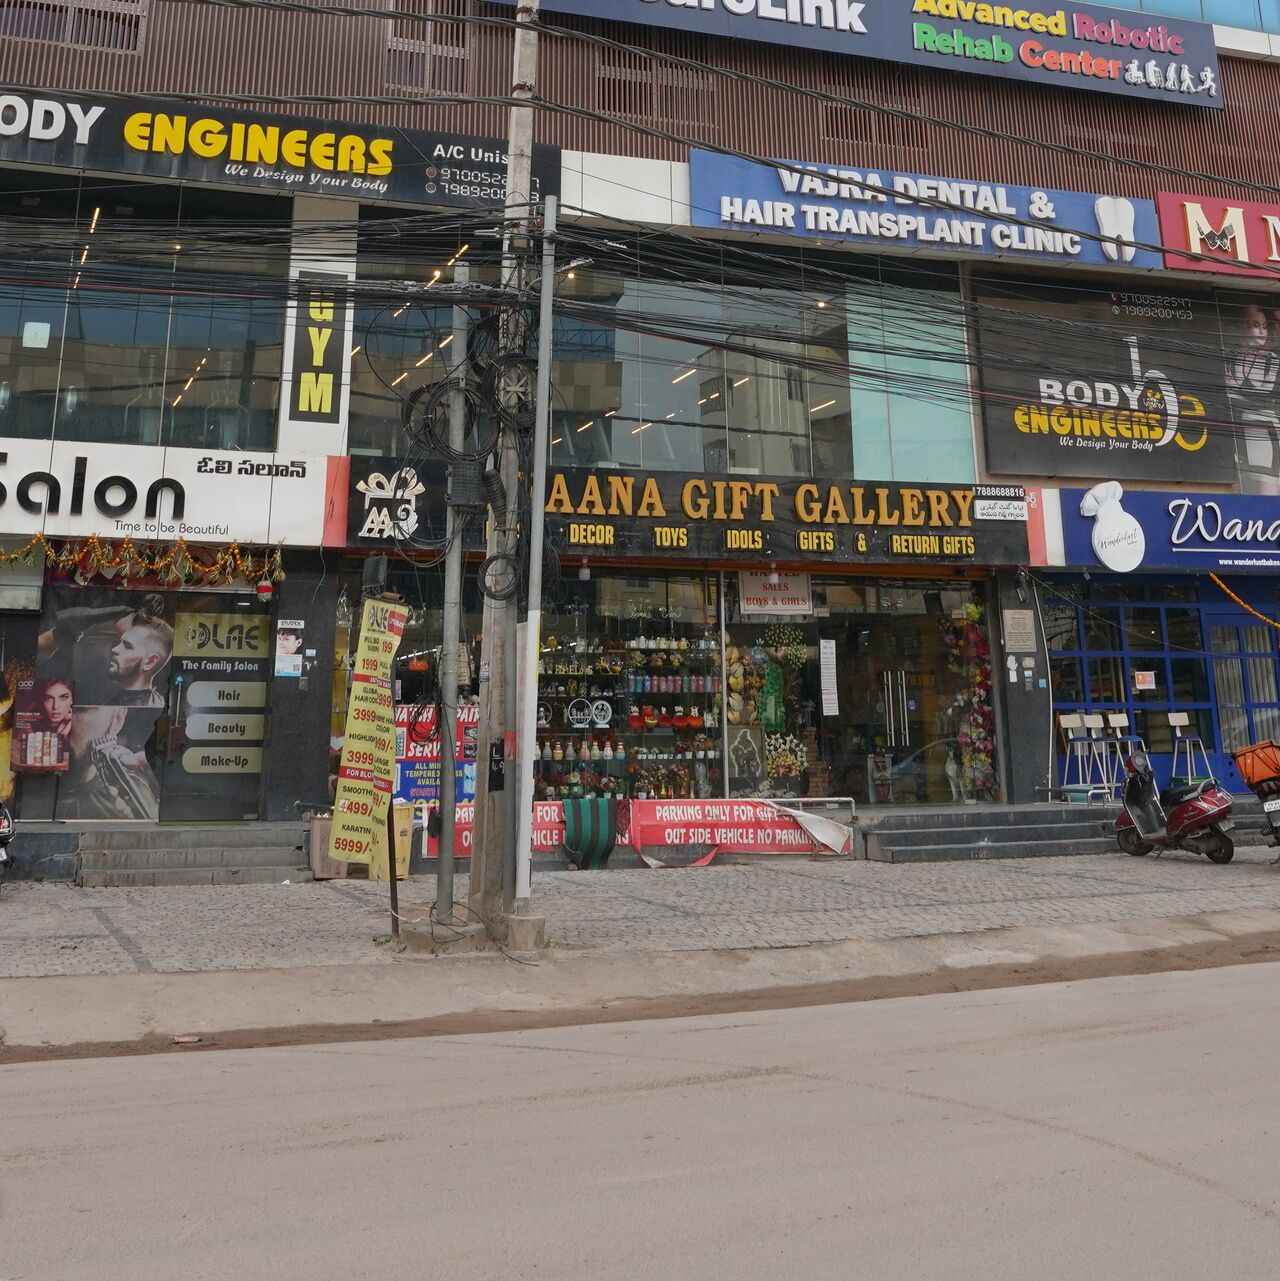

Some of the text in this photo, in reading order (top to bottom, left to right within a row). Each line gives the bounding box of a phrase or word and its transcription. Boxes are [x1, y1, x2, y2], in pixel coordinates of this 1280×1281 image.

[1072, 13, 1185, 55] Robotic
[912, 22, 1121, 79] Rehab Center
[123, 112, 393, 176] ENGINEERS
[433, 143, 464, 160] A/C
[224, 163, 248, 177] We
[253, 167, 304, 185] Design
[351, 177, 389, 194] Body
[440, 167, 540, 189] 97005227
[440, 183, 540, 202] 79892003
[777, 165, 1056, 219] VAJRA DENTAL &
[720, 196, 1081, 255] HAIR TRANSPLANT CLINIC
[298, 292, 334, 414] GYM
[1014, 378, 1163, 439] BODY ENGINEERS
[1059, 436, 1153, 452] We Design Your Body
[544, 473, 976, 527] AANA GIFT GALLERY
[114, 521, 230, 535] Time to be Beautiful
[570, 523, 975, 555] DECOR TOYS IDOLS GIFTS & RETURN GIFTS
[762, 582, 788, 592] SALES
[745, 597, 807, 606] BOYS & GIRLS
[182, 660, 259, 673] The Family Salon
[218, 690, 241, 701] Hair
[207, 722, 246, 736] Beauty
[200, 755, 249, 768] Make-Up
[346, 751, 374, 765] 3999
[537, 804, 558, 821] FOR
[656, 805, 754, 822] PARKING ONLY FOR
[665, 829, 772, 845] OUT SIDE VEHICLE NO
